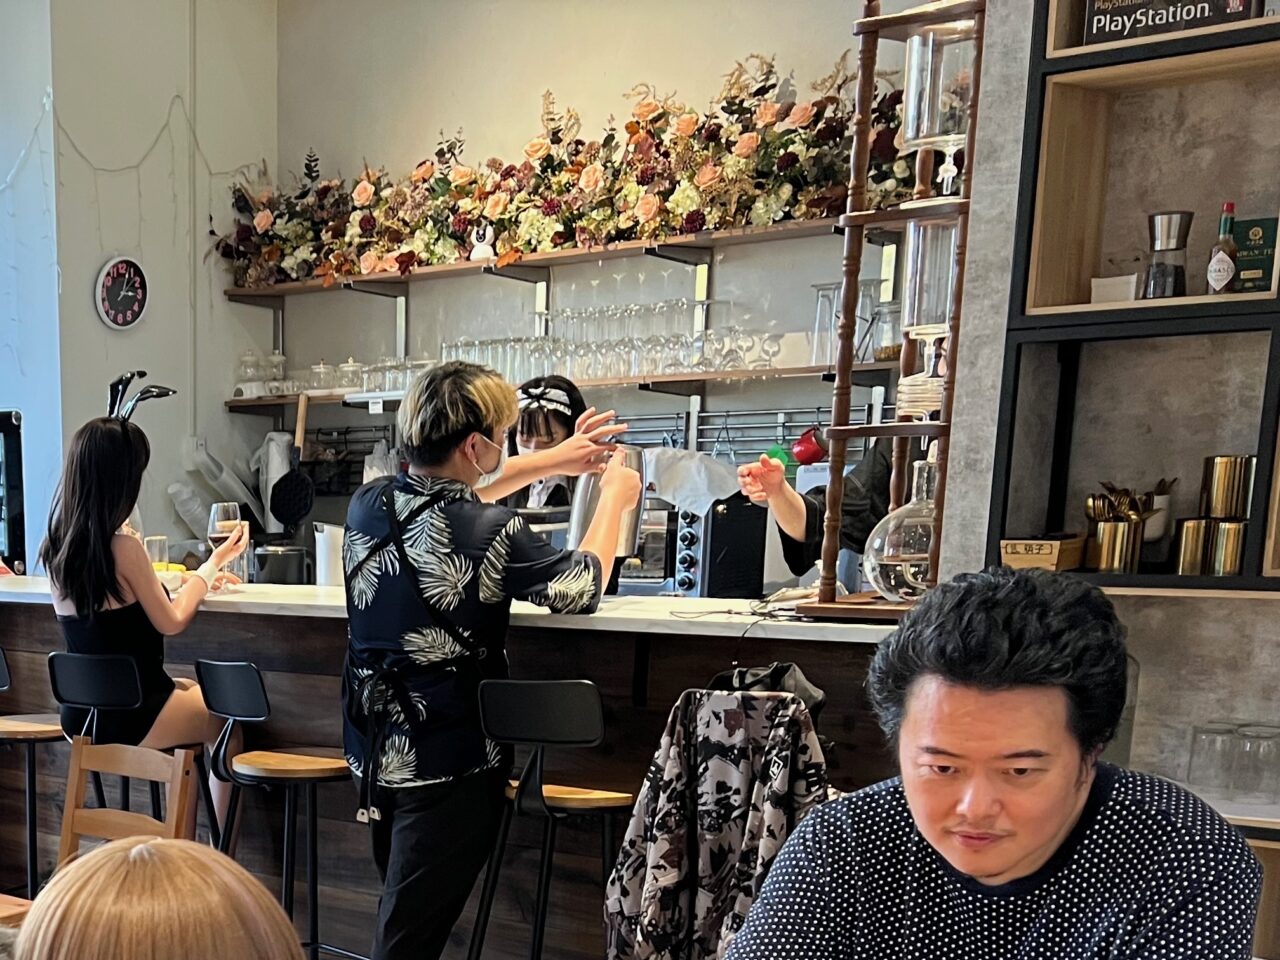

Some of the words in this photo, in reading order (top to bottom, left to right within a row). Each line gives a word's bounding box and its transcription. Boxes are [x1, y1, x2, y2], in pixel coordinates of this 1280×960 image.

[1092, 3, 1209, 36] PlayStation
[118, 263, 126, 273] 12
[134, 277, 140, 287] 2
[136, 289, 142, 299] 3
[117, 313, 123, 324] 6
[126, 310, 132, 320] 5
